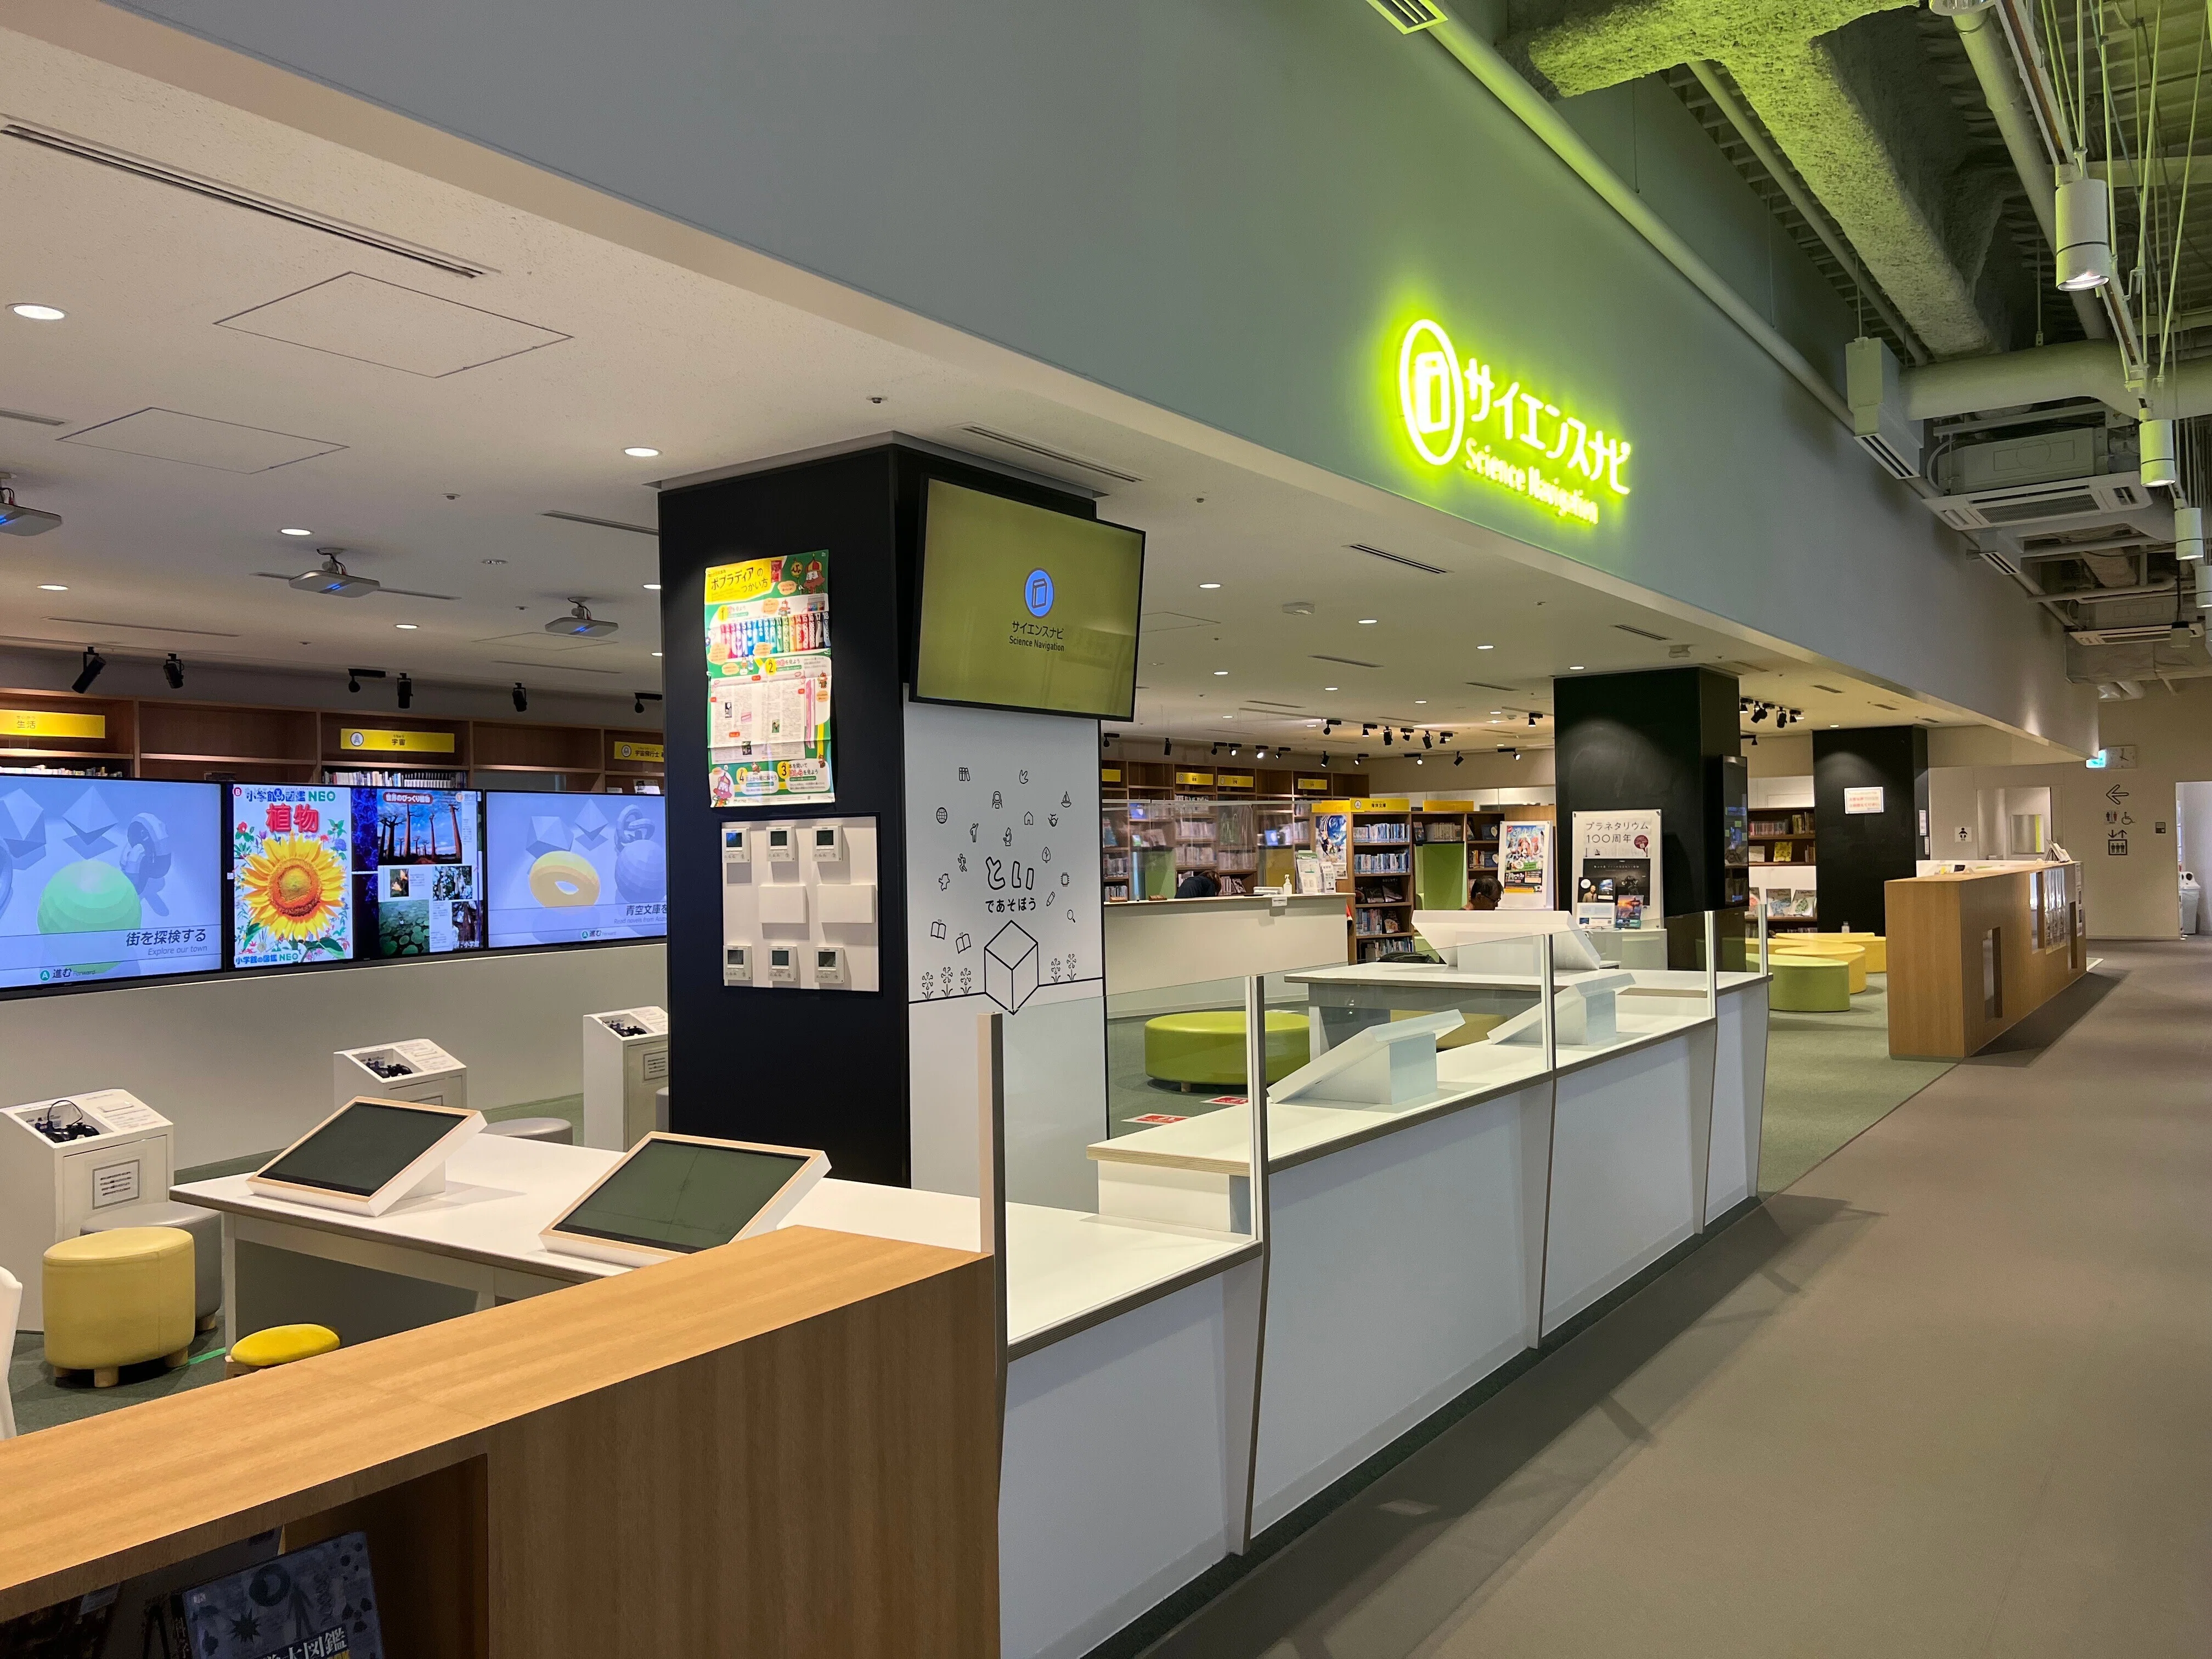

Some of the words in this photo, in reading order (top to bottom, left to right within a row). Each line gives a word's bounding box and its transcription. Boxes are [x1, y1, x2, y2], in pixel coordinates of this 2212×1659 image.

[1465, 358, 1632, 494] サイエンスナビ
[1465, 437, 1526, 492] Science
[1528, 466, 1599, 524] Navigation
[741, 578, 768, 592] つかい方
[1012, 620, 1064, 640] サイエンスナビ
[1009, 635, 1032, 647] Science
[1034, 639, 1065, 651] Navigation
[769, 662, 774, 673] 2
[16, 720, 36, 729] 生活
[782, 765, 787, 776] 3
[308, 791, 336, 802] NEO
[266, 803, 319, 833] 植物
[1585, 821, 1649, 831] プラネタリウム
[985, 897, 1036, 913] であそぼう
[126, 928, 206, 947] 街を探検する
[148, 947, 174, 956] Explore
[279, 953, 298, 961] NEO
[52, 968, 72, 979] 進む
